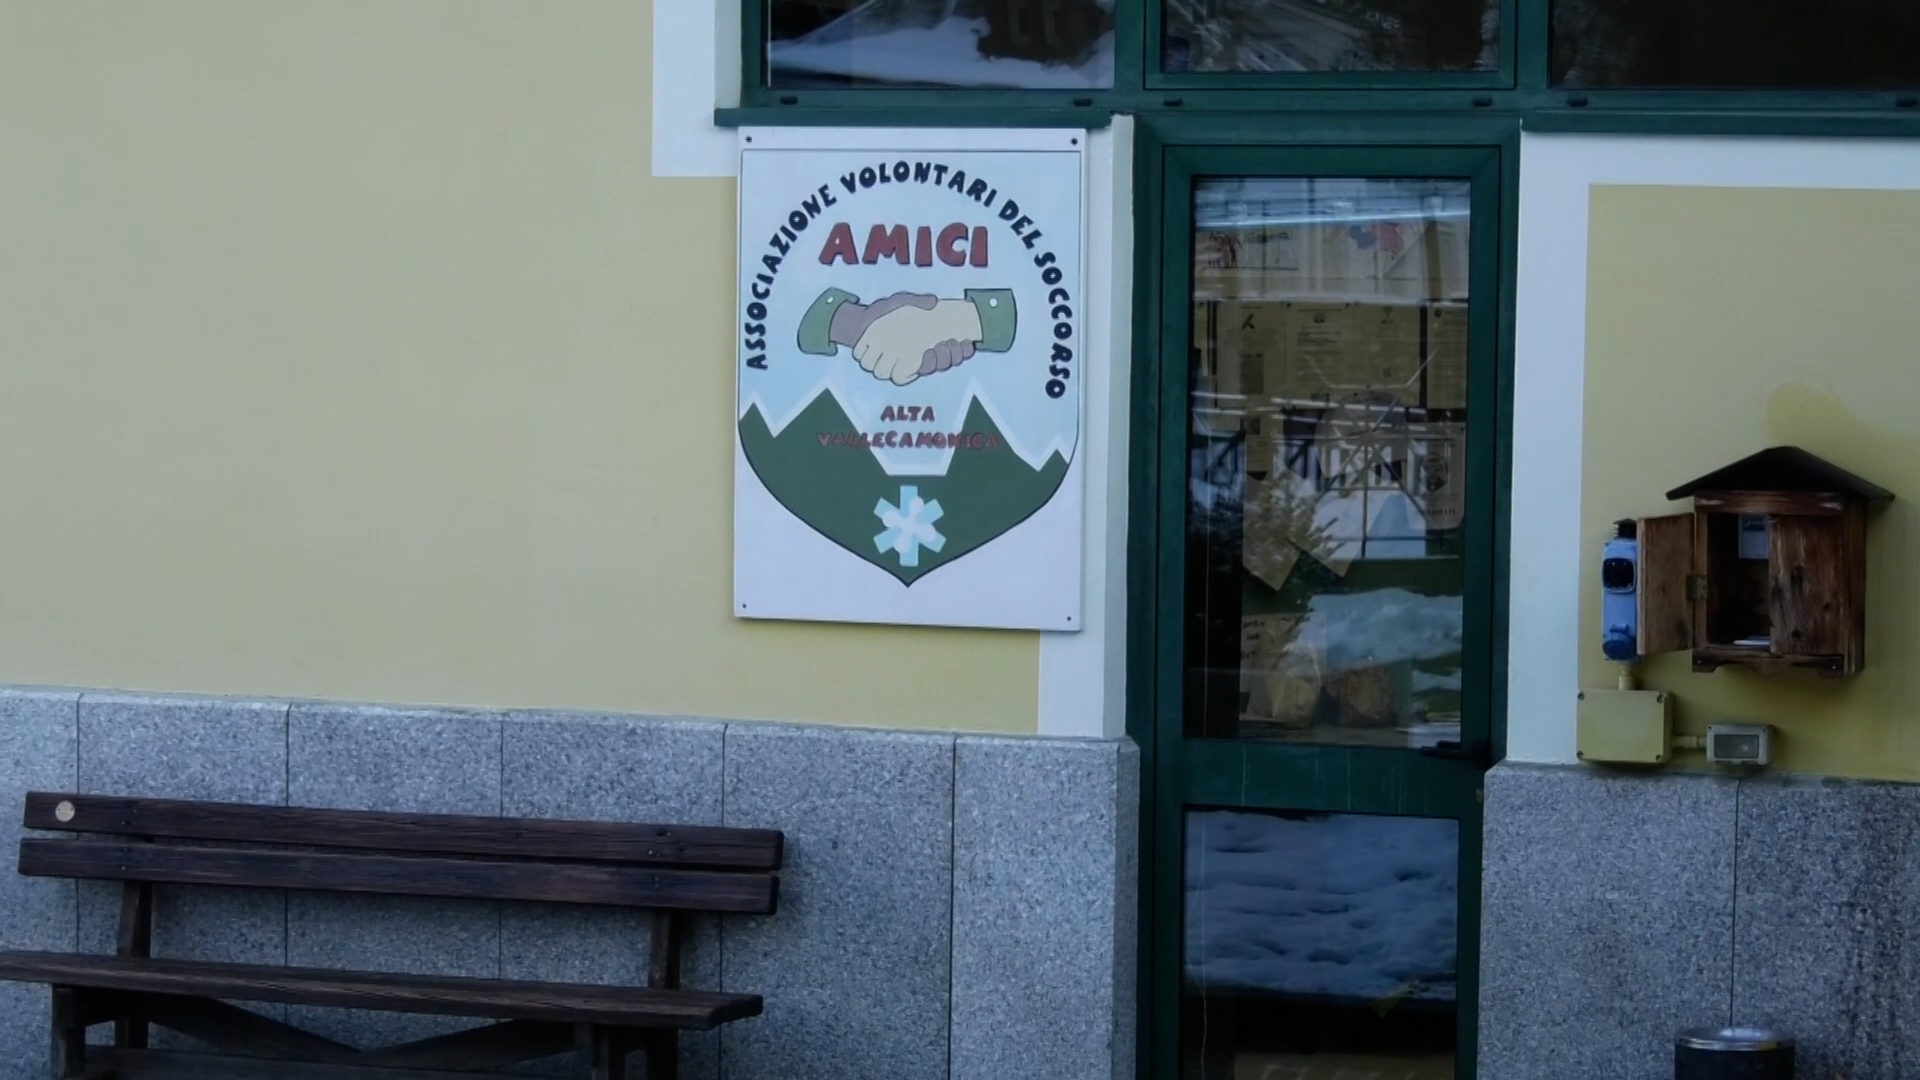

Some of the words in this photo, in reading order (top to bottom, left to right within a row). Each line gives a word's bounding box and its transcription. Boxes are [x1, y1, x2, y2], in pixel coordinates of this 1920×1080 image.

[818, 222, 989, 268] AMICI
[744, 184, 837, 371] ASSOCIAZIONE
[840, 160, 997, 207] VOLONTARI
[998, 199, 1043, 250] DEL
[1034, 251, 1073, 399] SOCCORSO
[880, 405, 935, 422] ALTA
[817, 431, 1001, 449] VALLECAMONICA
